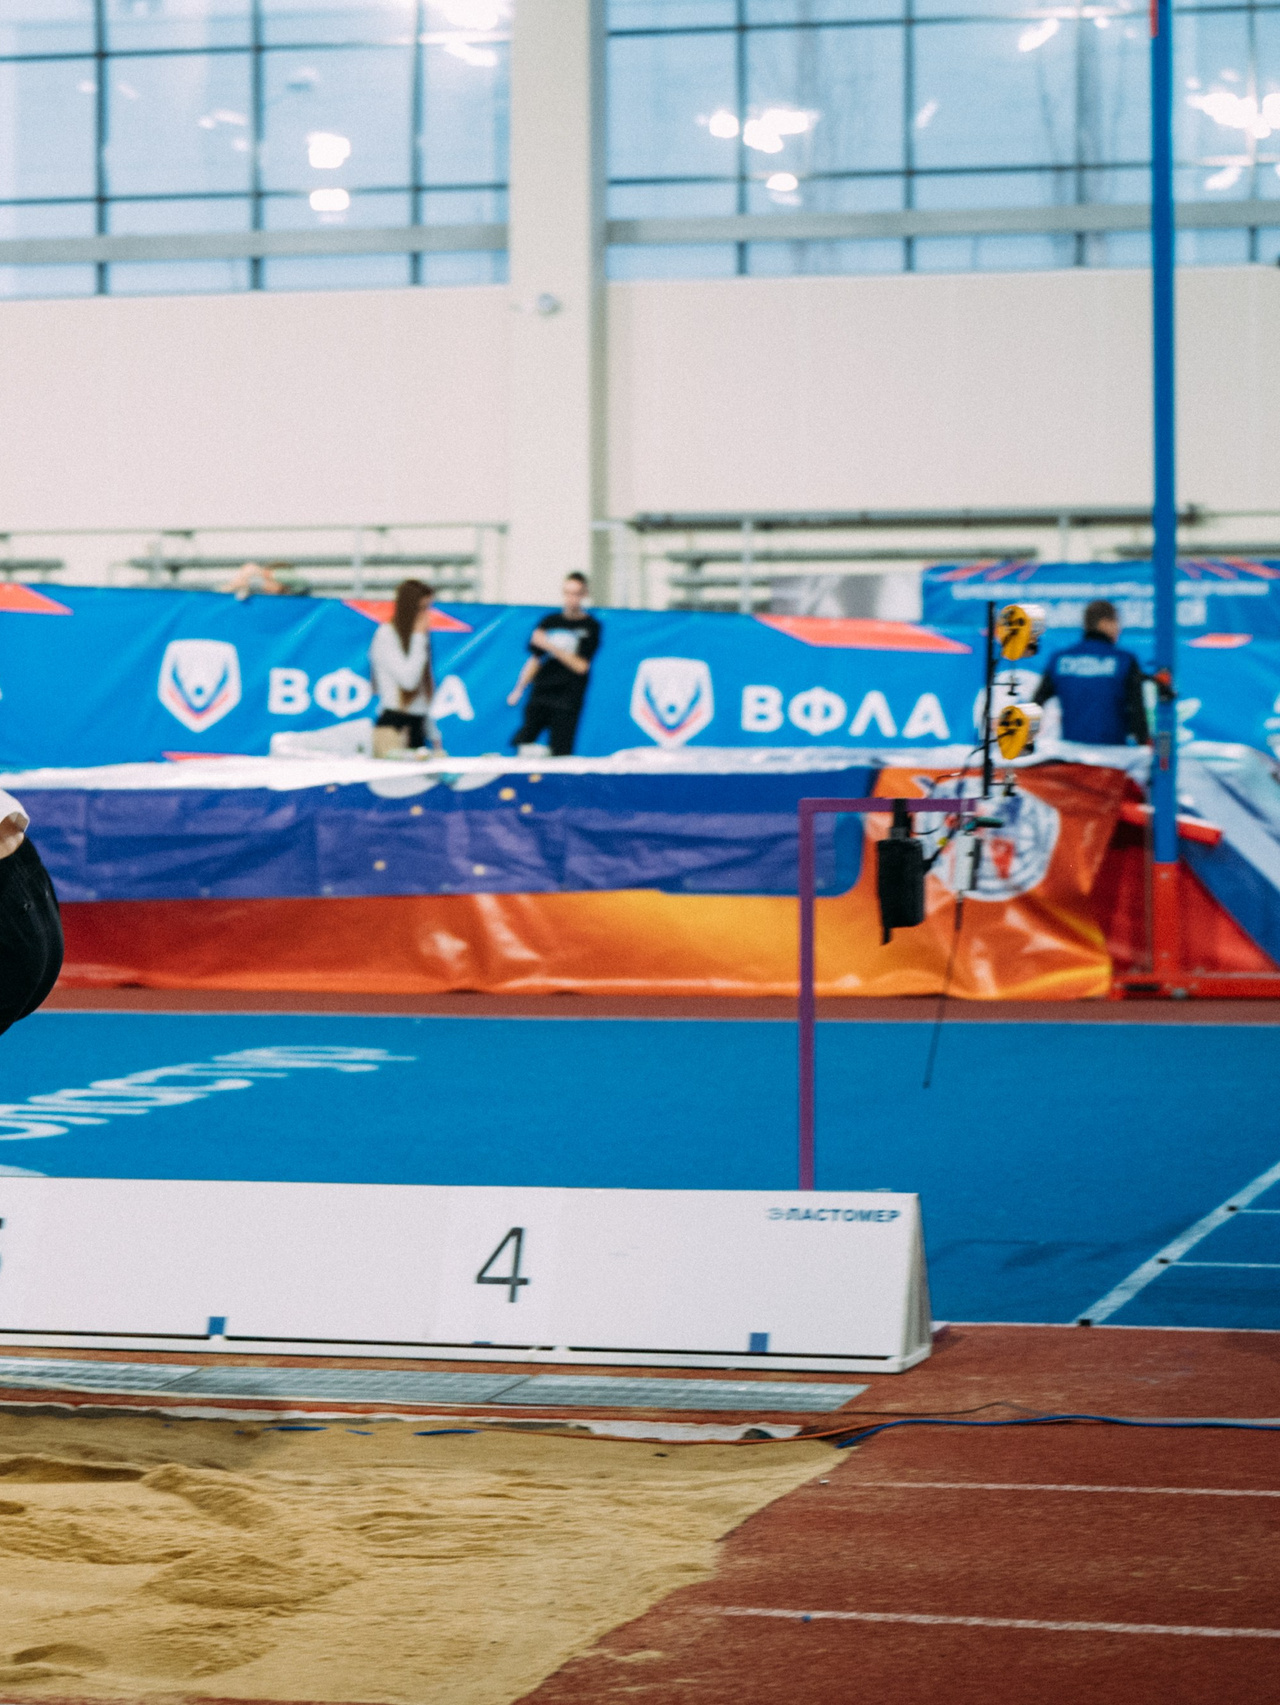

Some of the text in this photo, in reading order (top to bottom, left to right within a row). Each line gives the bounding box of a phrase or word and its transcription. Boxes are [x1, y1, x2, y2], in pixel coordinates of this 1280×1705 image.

[268, 667, 474, 721] ВФА
[741, 685, 951, 740] ВФЛА
[475, 1226, 530, 1303] 4
